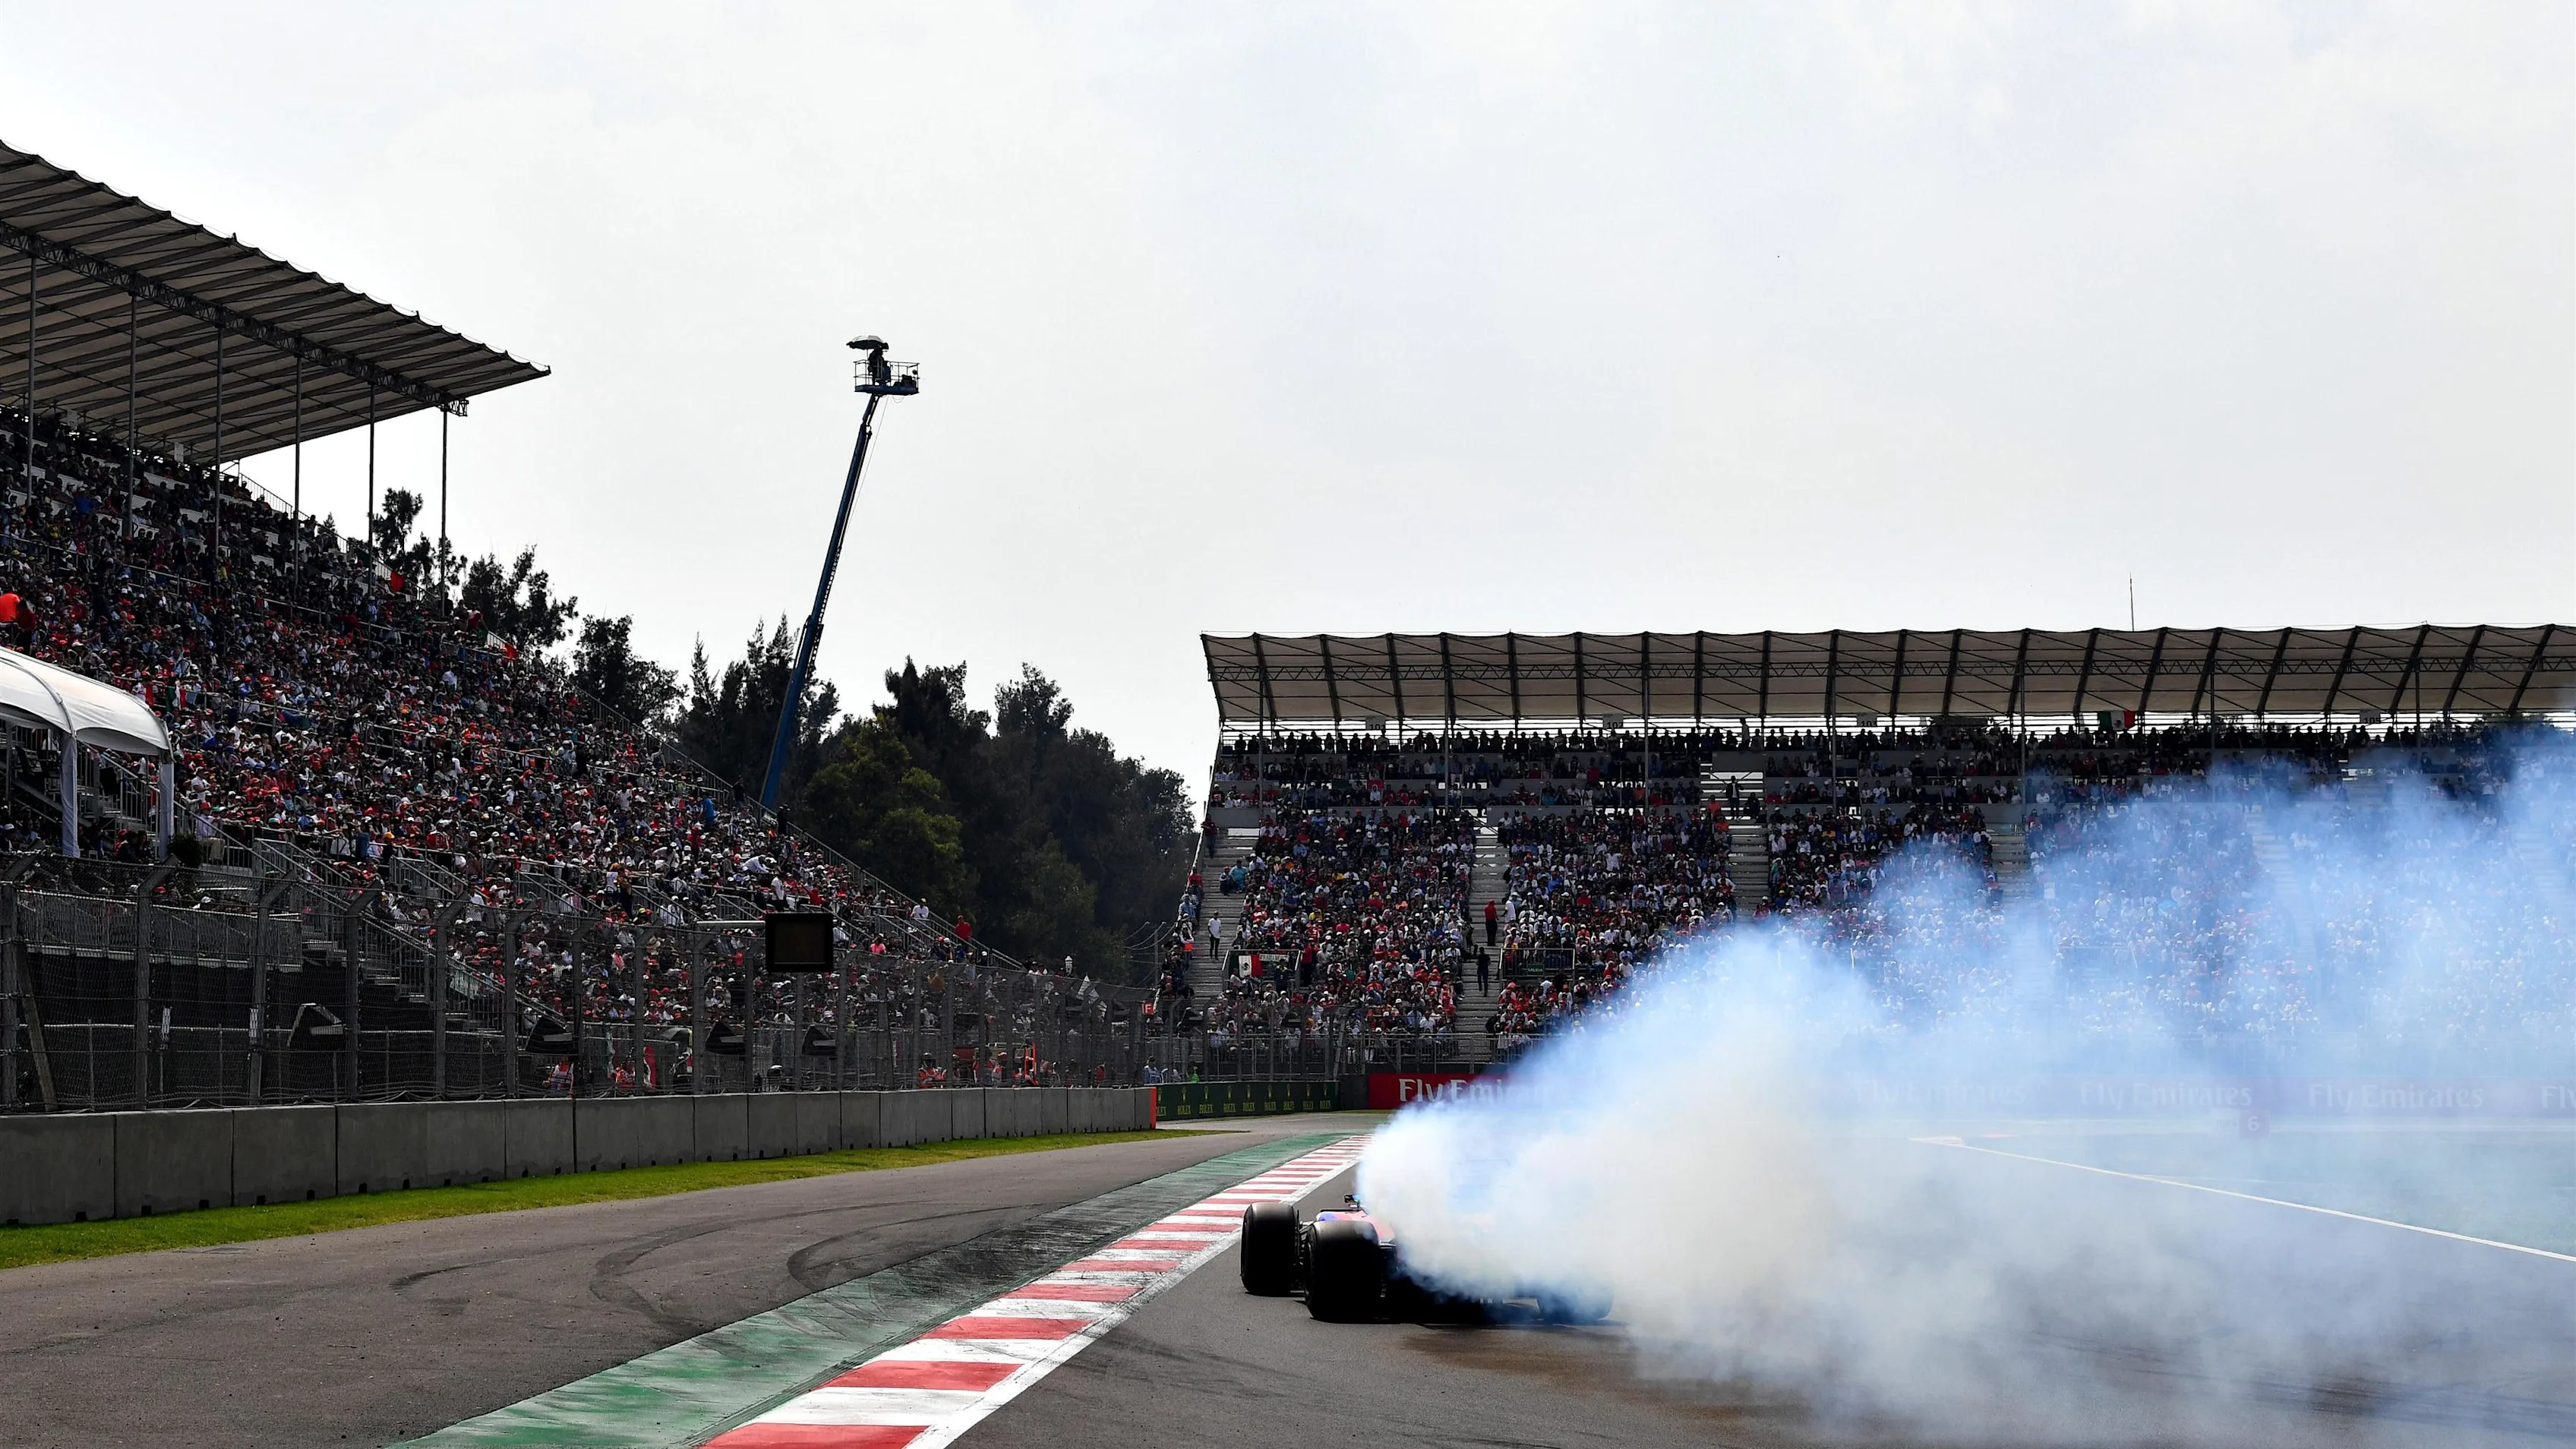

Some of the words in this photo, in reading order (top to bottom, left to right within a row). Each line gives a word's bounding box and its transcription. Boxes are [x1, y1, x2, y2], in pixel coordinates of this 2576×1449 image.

[2080, 1081, 2125, 1110] Fly
[2132, 1080, 2253, 1106] Emirates
[2308, 1084, 2354, 1113] Fly
[2360, 1082, 2483, 1109] Emirates
[2248, 1116, 2260, 1132] 6
